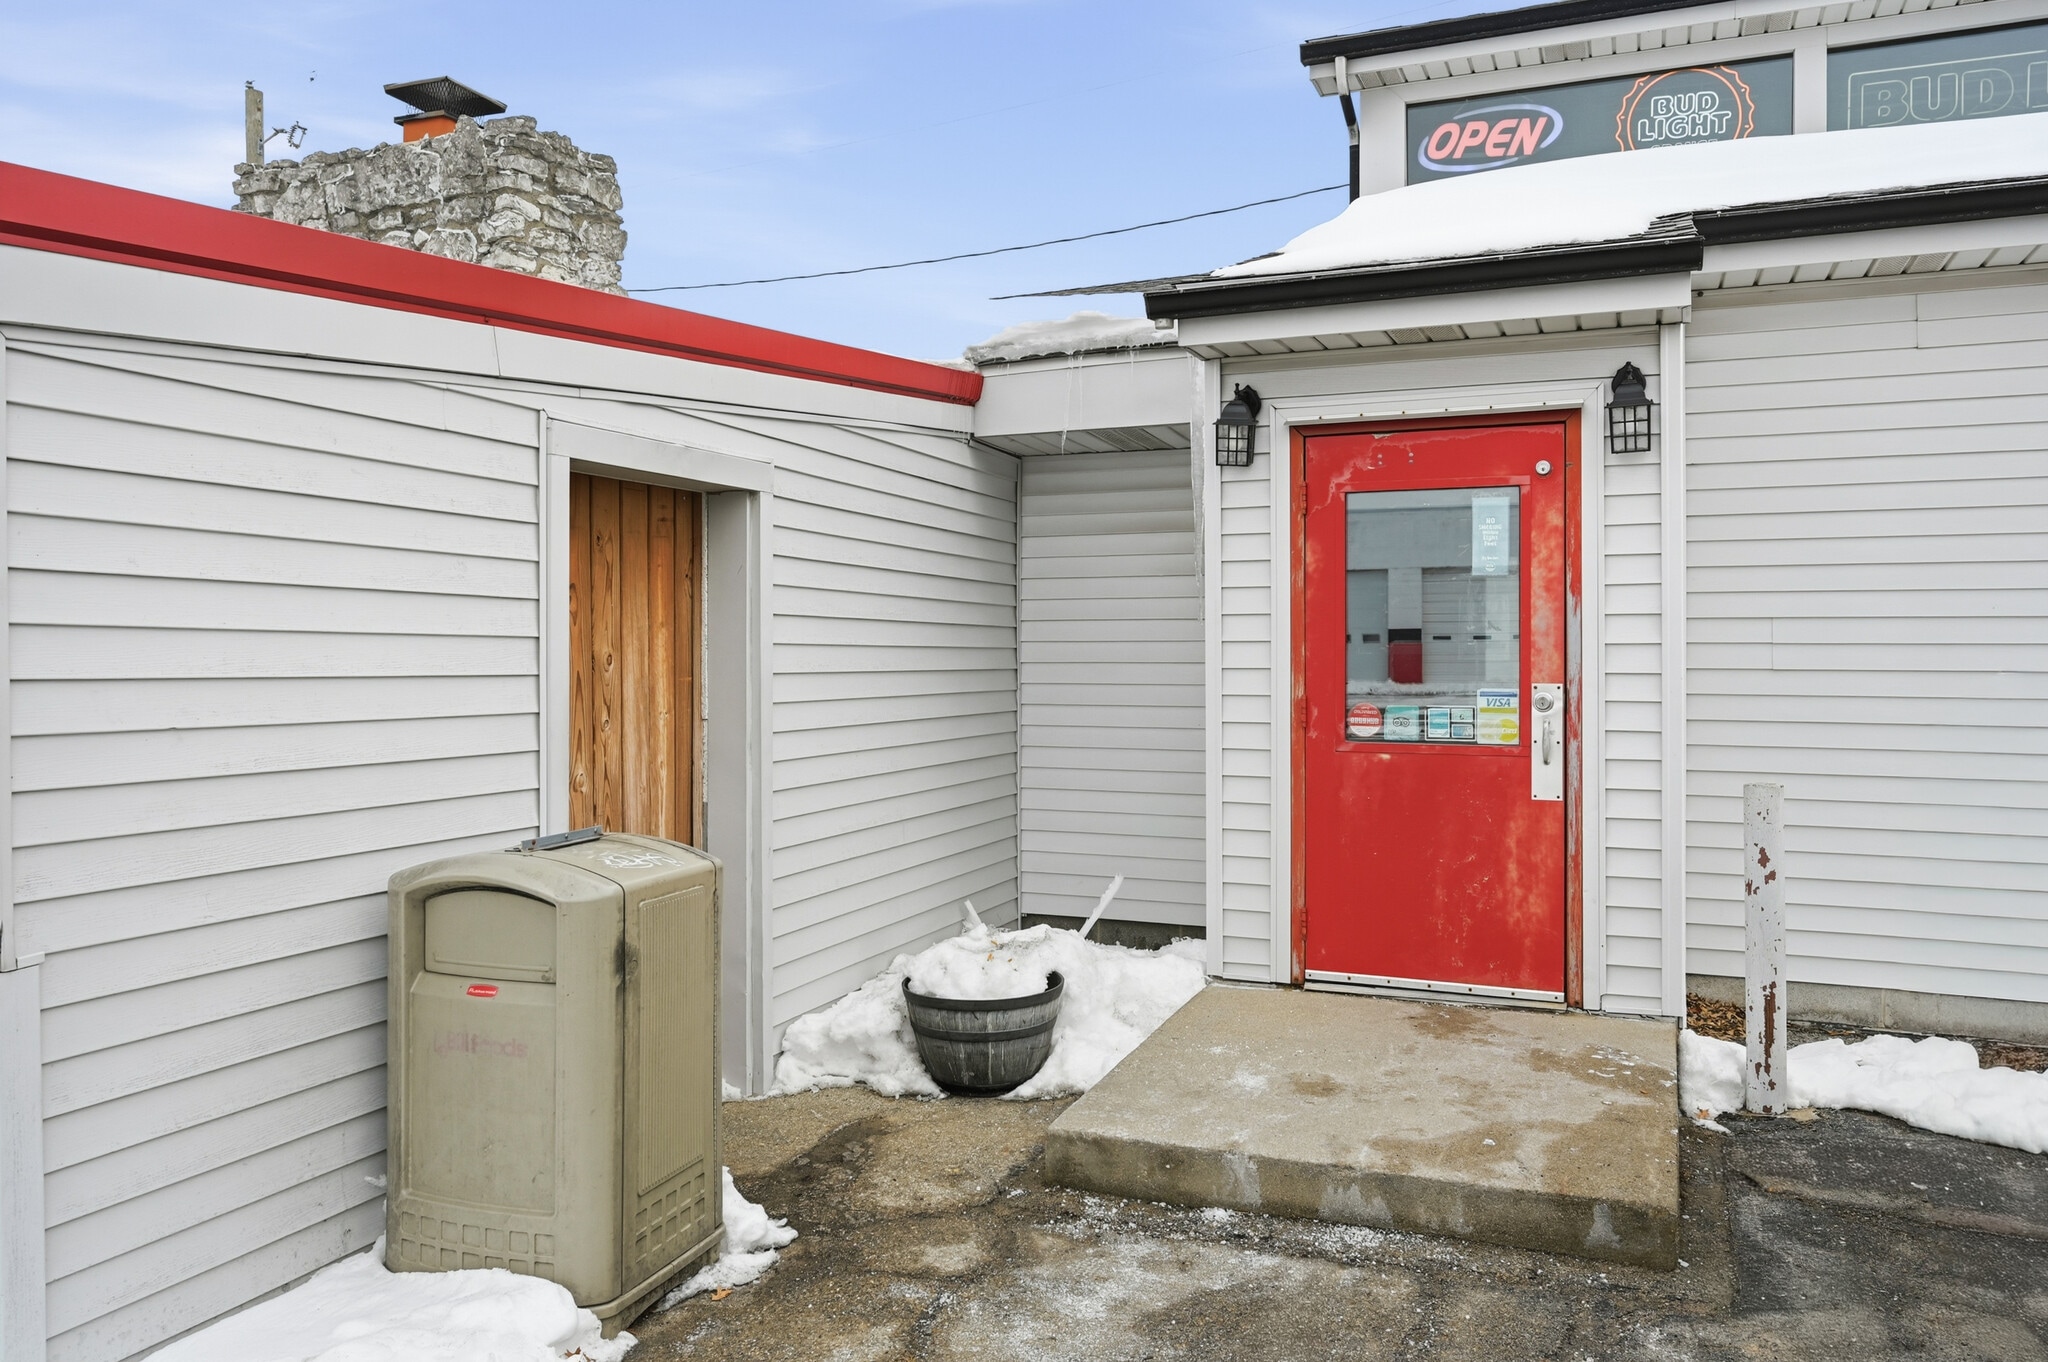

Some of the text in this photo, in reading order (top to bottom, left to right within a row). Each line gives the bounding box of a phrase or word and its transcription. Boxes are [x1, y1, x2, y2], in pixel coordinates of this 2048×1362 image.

[1650, 91, 1719, 119] BUD
[1860, 67, 2014, 127] BUD
[1427, 116, 1548, 161] OPEN
[1637, 110, 1732, 142] LIGHT
[1486, 697, 1511, 707] VISA
